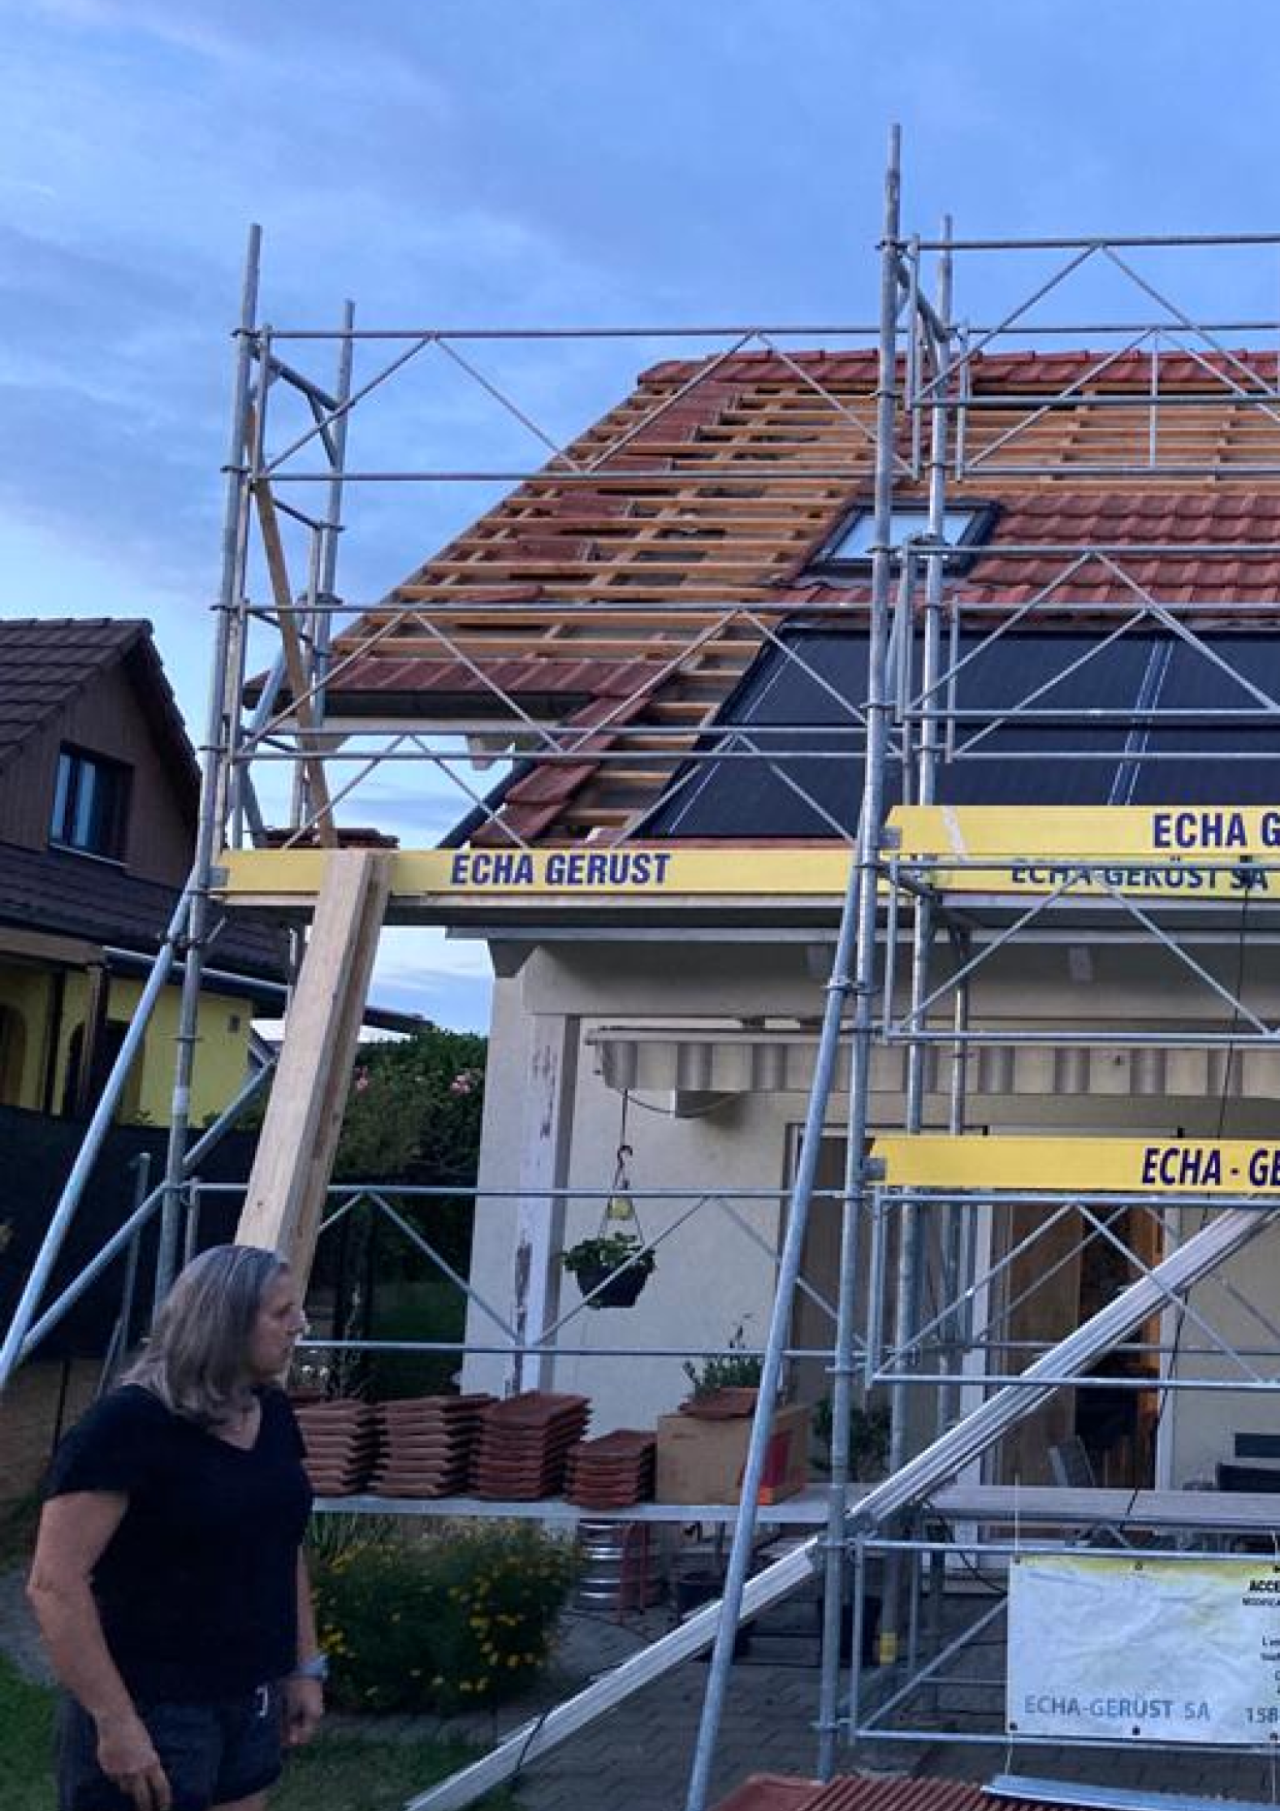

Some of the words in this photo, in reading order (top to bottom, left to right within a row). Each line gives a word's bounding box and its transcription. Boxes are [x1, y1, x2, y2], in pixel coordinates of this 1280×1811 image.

[1153, 811, 1248, 848] ECHA
[451, 852, 533, 885] ECHA
[544, 852, 671, 885] GERUST
[1142, 1147, 1221, 1185] ECHA
[1184, 1701, 1211, 1721] SA
